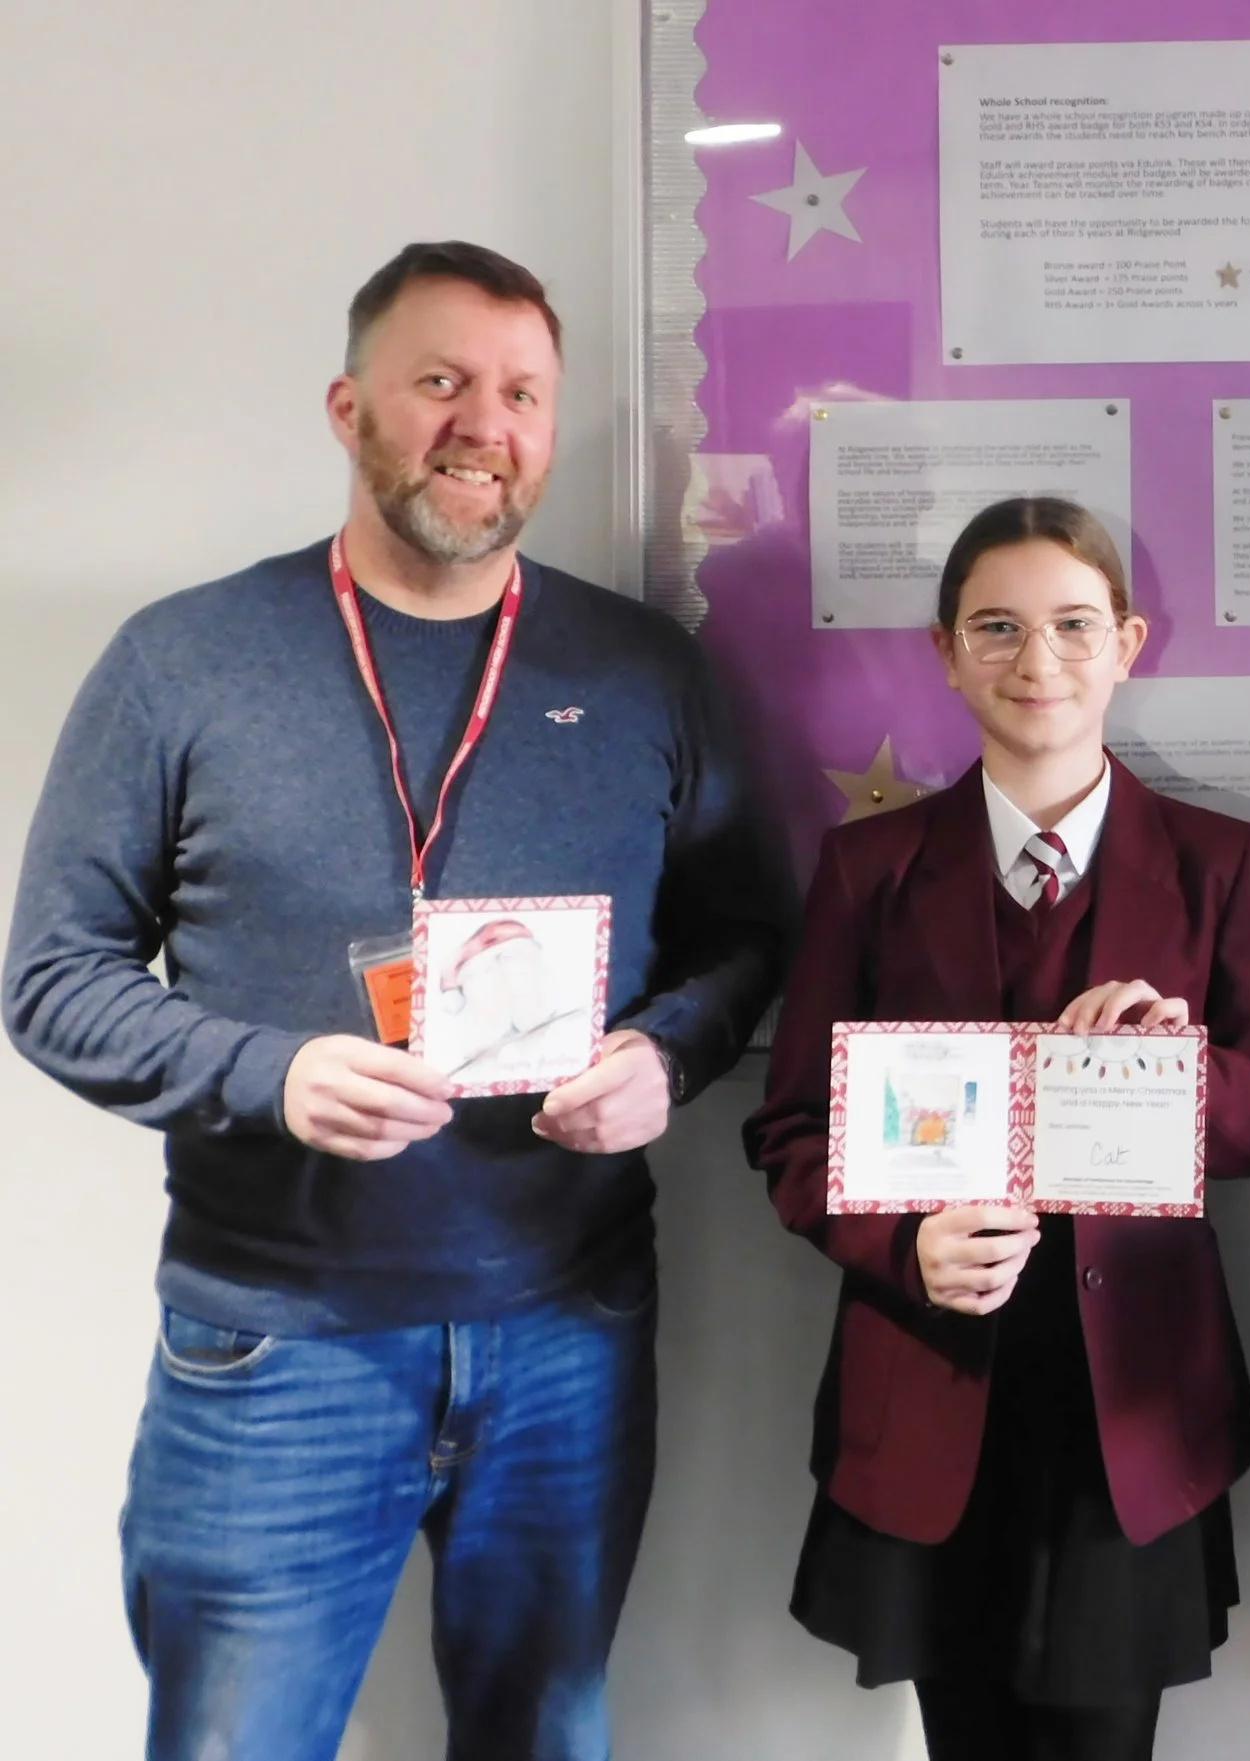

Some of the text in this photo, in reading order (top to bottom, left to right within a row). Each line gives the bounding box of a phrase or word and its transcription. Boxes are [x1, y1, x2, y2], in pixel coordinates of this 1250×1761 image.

[980, 97, 1012, 106] Whole
[1013, 97, 1047, 106] School
[997, 111, 1021, 120] have
[1063, 110, 1095, 120] school
[1097, 110, 1153, 121] recognition
[1198, 109, 1226, 118] made
[979, 122, 1002, 131] Gold
[1004, 121, 1023, 130] and
[1047, 121, 1078, 130] award
[1079, 121, 1110, 131] badge
[1112, 120, 1126, 129] for
[1128, 120, 1151, 129] both
[1173, 120, 1192, 129] and
[1008, 131, 1043, 140] awards
[1045, 131, 1062, 140] the
[1108, 130, 1133, 139] need
[980, 160, 1002, 169] Staff
[1003, 160, 1021, 169] will
[1023, 160, 1054, 169] award
[1056, 160, 1086, 170] praise
[1088, 159, 1118, 170] points
[1178, 159, 1207, 168] These
[1208, 159, 1226, 167] will
[1228, 158, 1250, 167] then
[1017, 169, 1080, 179] achievement
[1082, 169, 1120, 178] module
[1121, 169, 1140, 178] and
[1142, 169, 1177, 179] badges
[1179, 169, 1196, 177] will
[1198, 168, 1211, 177] be
[1065, 179, 1083, 188] will
[1084, 179, 1124, 188] monitor
[1126, 179, 1143, 187] the
[1145, 178, 1194, 189] rewarding
[1208, 178, 1243, 188] badges
[980, 219, 1023, 228] Students
[1024, 219, 1042, 228] will
[1044, 219, 1068, 228] have
[1070, 219, 1087, 227] the
[1088, 218, 1147, 229] opportunity
[1162, 218, 1175, 226] be
[1177, 217, 1219, 226] awarded
[1221, 217, 1238, 226] the
[980, 229, 1011, 240] during
[1013, 229, 1037, 238] each
[1086, 230, 1112, 239] years
[1126, 227, 1181, 238] Ridgewood
[1107, 1086, 1135, 1097] Merry
[1138, 1086, 1187, 1096] Christmas
[1088, 1099, 1120, 1110] Happy
[1122, 1100, 1143, 1109] New
[1090, 1141, 1131, 1167] Cat
